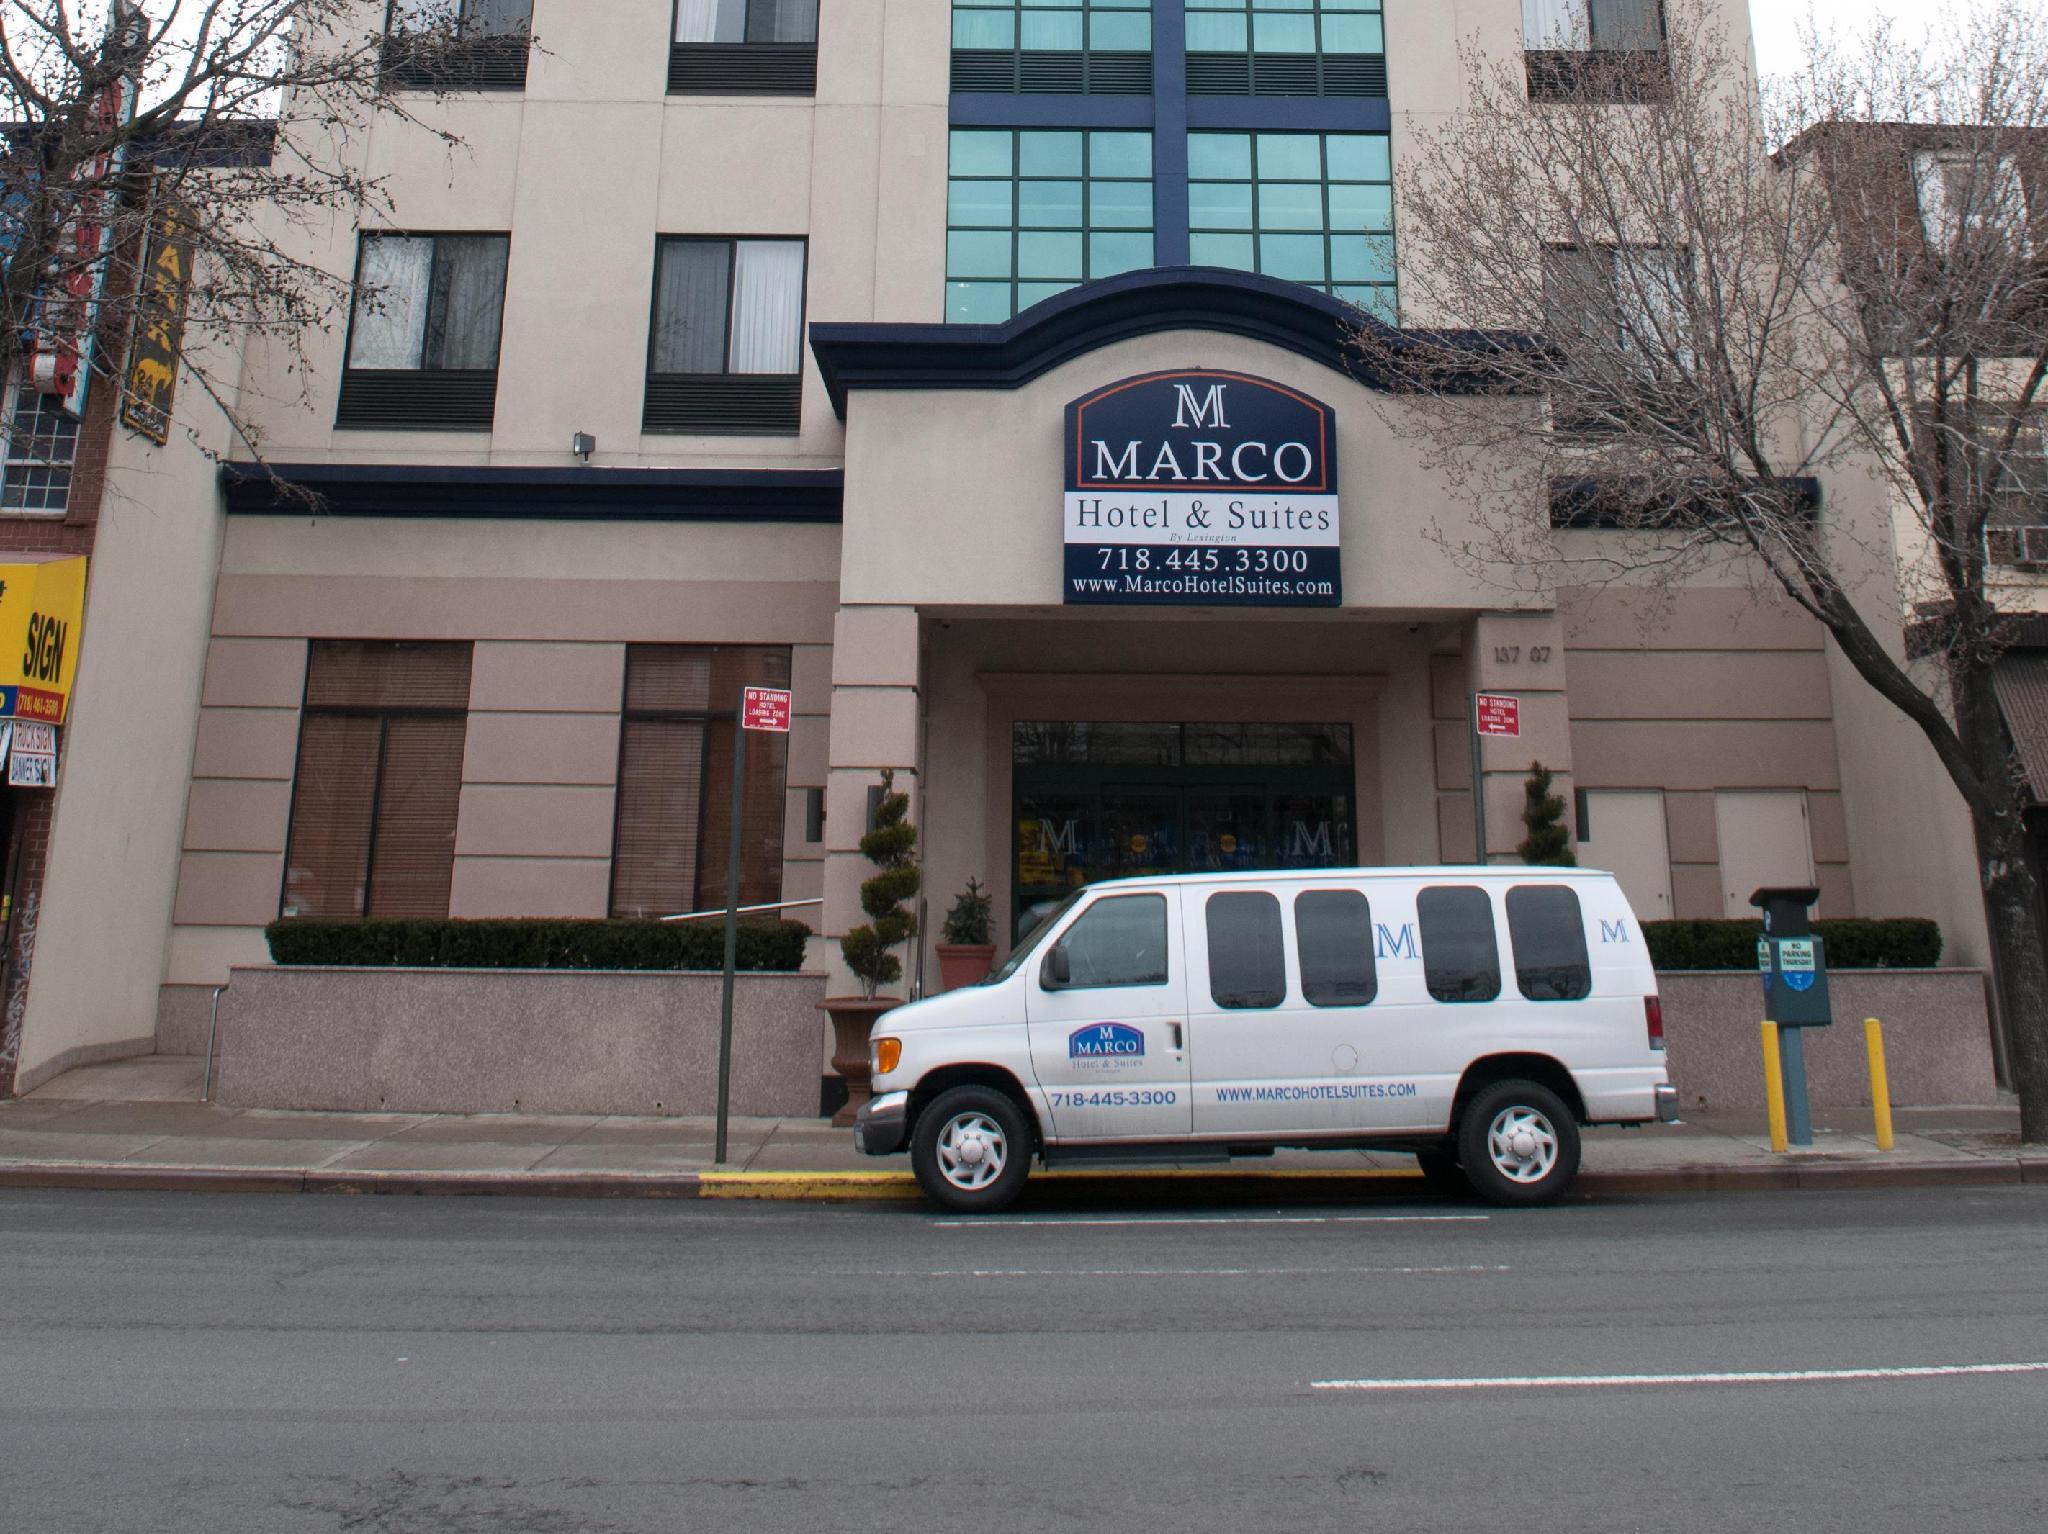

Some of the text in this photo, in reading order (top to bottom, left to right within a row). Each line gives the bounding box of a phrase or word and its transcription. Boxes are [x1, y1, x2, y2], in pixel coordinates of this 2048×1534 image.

[1171, 384, 1231, 429] M
[1091, 440, 1312, 482] MARCO
[1077, 499, 1330, 530] Hotel & Suites
[1097, 548, 1308, 572] 718.445.3300
[1073, 575, 1334, 595] www.MarcoHotelSuites.com
[23, 611, 68, 683] SIGN
[748, 692, 788, 703] NO STANDING
[1479, 698, 1516, 708] NO STANDING
[1600, 919, 1629, 943] M
[1374, 923, 1422, 960] M
[1791, 942, 1802, 950] NO
[1782, 950, 1812, 958] PARKING
[1100, 1026, 1114, 1040] M
[1077, 1040, 1137, 1055] MARCO
[1072, 1059, 1143, 1069] Hotel & Suites
[1051, 1090, 1176, 1107] 718-445-3300
[1216, 1083, 1416, 1102] WWW.MARCOHOTELSUITES.COM
